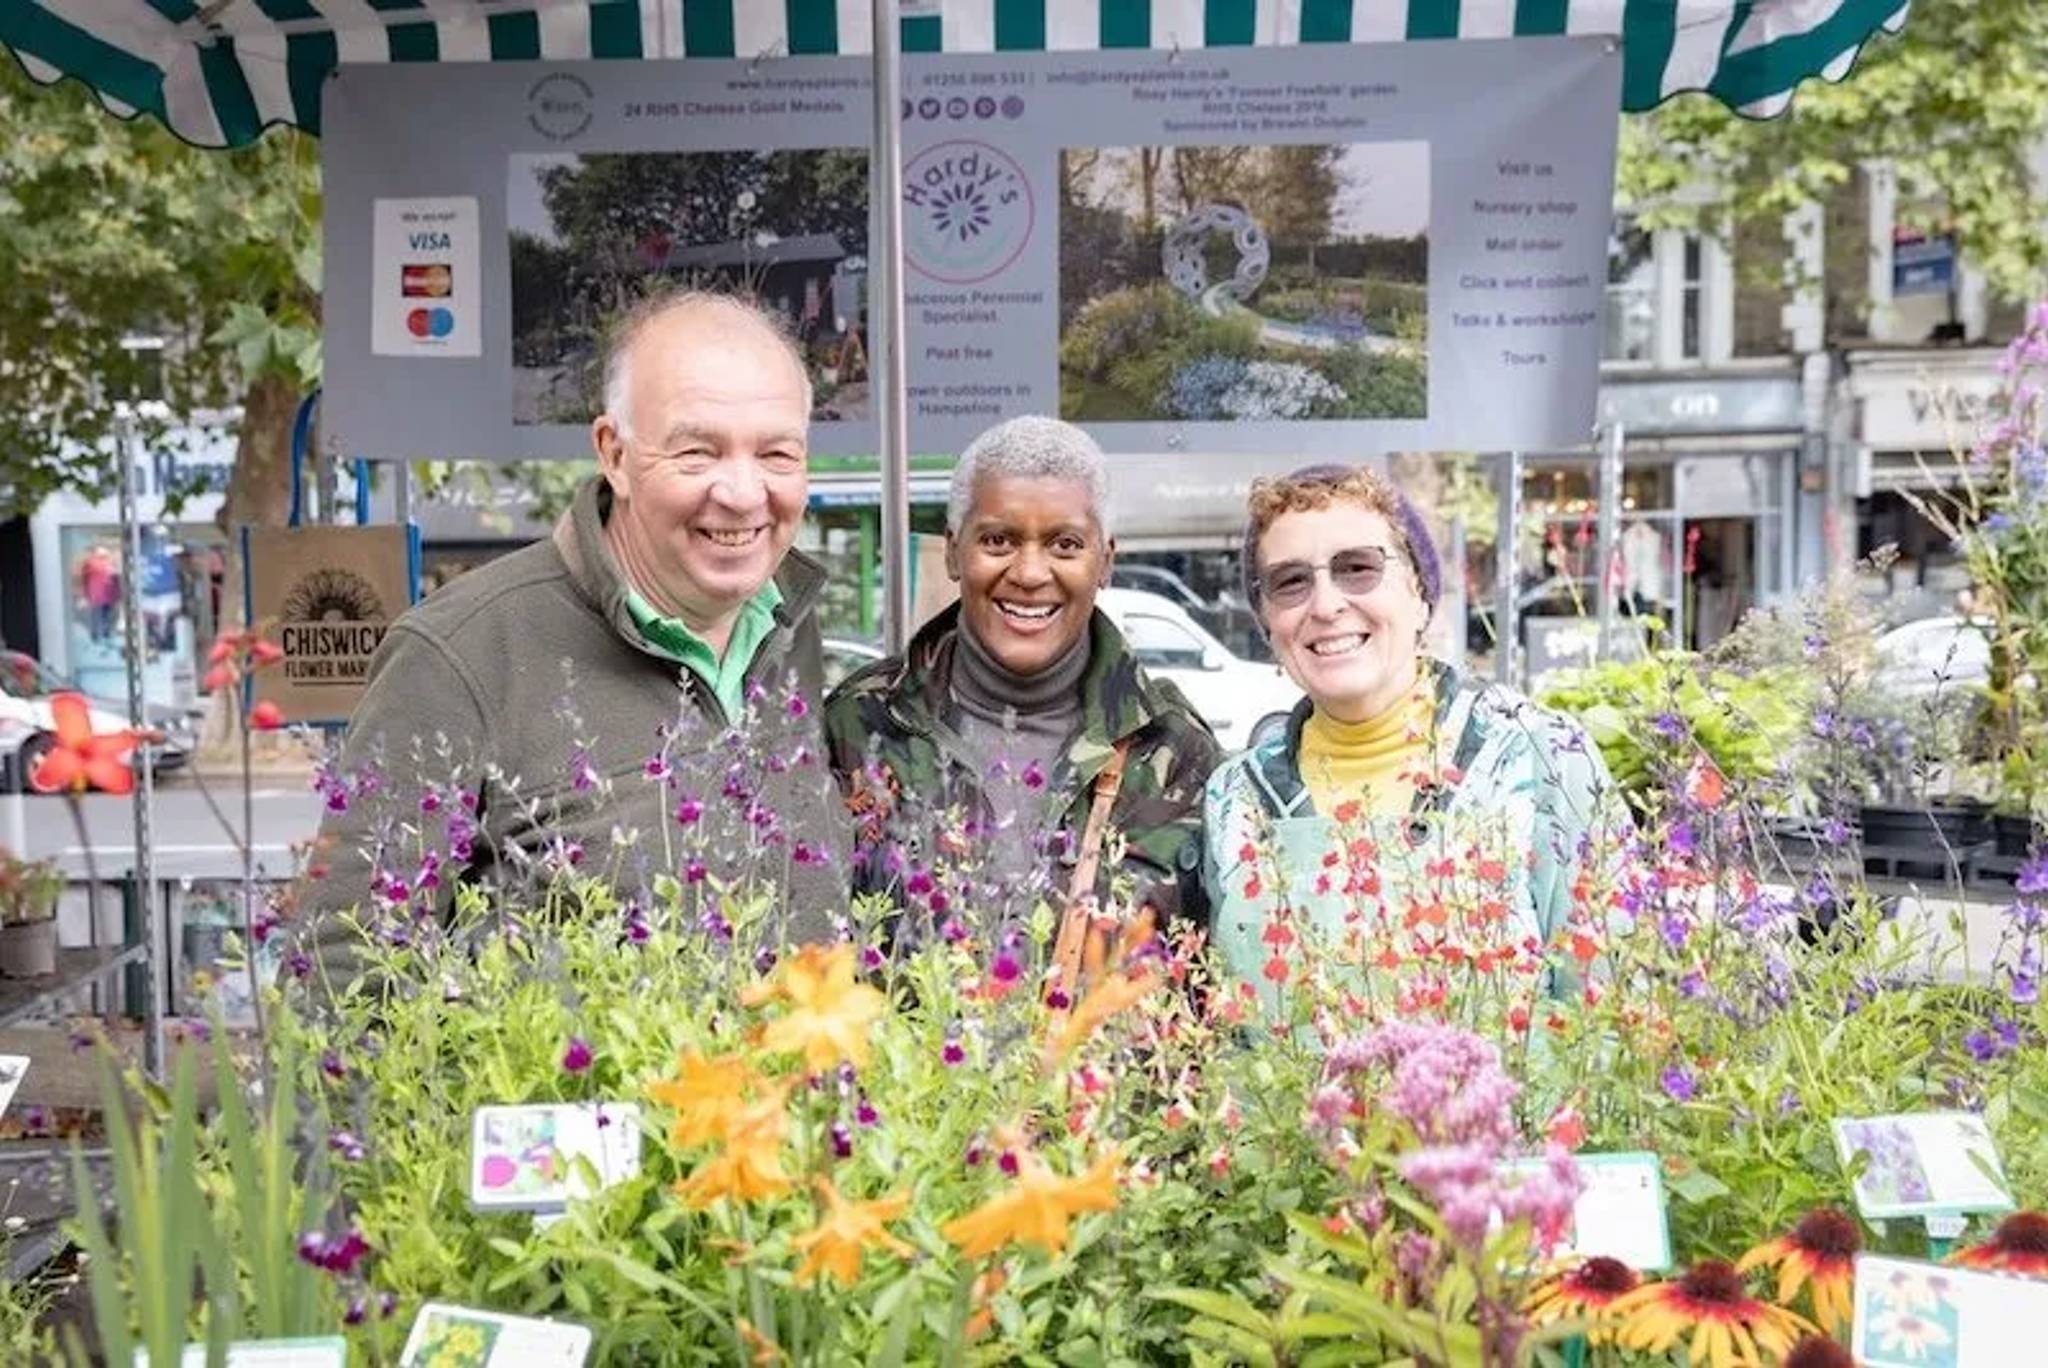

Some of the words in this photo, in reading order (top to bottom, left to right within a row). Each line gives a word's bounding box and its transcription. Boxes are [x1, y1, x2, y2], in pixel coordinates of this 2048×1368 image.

[624, 102, 641, 117] 24
[645, 102, 679, 117] RHS
[683, 101, 745, 116] Chelsea
[750, 101, 787, 114] Gold
[790, 99, 845, 113] Medals
[1236, 101, 1291, 114] Chelsea
[1498, 161, 1531, 176] Visit
[1534, 164, 1553, 176] us
[903, 151, 1019, 207] Hardy's
[1474, 200, 1533, 216] Nursery
[1537, 201, 1578, 216] shop
[408, 231, 452, 251] VISA
[1485, 237, 1517, 250] Mail
[1521, 238, 1564, 250] order
[1459, 274, 1497, 289] Click
[1503, 275, 1533, 288] and
[1535, 273, 1590, 288] collect
[971, 290, 1044, 303] Perennial
[922, 310, 998, 325] Specialist
[1452, 312, 1491, 327] Talks
[1496, 313, 1508, 327] &
[1512, 311, 1597, 328] workshops
[926, 348, 960, 360] Peat
[963, 346, 993, 359] free
[1503, 350, 1547, 365] Tours
[943, 385, 1013, 397] outdoors
[1015, 385, 1032, 396] in
[918, 402, 1002, 416] Hampshire
[285, 661, 335, 679] FLOWER
